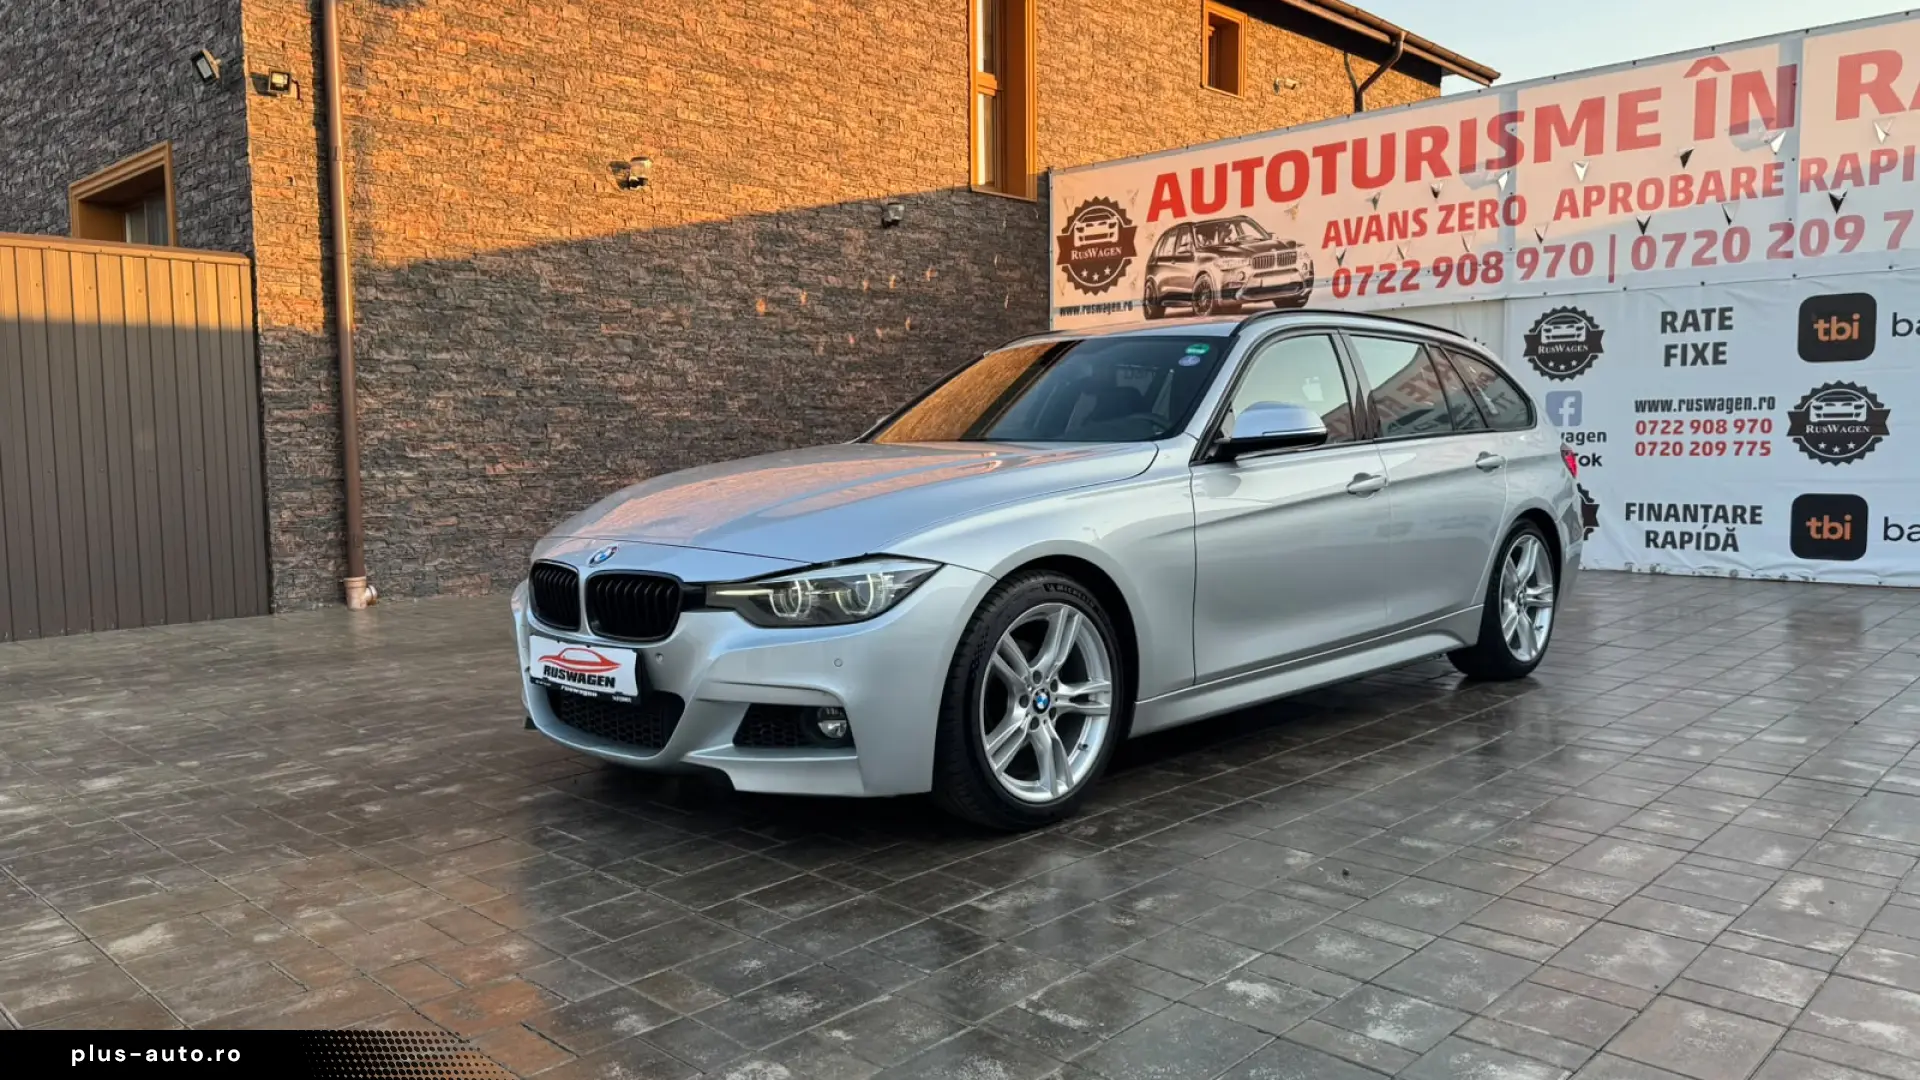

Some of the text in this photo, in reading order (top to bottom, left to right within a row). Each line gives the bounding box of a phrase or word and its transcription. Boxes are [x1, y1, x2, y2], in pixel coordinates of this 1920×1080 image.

[1146, 48, 1920, 223] AUTOTURISME ÎN R
[1321, 145, 1916, 249] AVANS ZERO APROBARE RAPI
[1332, 259, 1421, 299] 0722
[1432, 250, 1505, 289] 908
[1516, 241, 1594, 281] 970
[1631, 226, 1751, 272] 0720
[1766, 214, 1865, 260] 209
[1060, 301, 1133, 316] www.ruswagen.ro
[1661, 307, 1734, 334] RATE
[1813, 312, 1861, 341] tbi
[1664, 342, 1728, 367] FIXE
[1634, 396, 1776, 414] www.ruswagen.ro
[1635, 418, 1773, 435] 0722 908 970
[1635, 440, 1771, 456] 0720 209 775
[1645, 526, 1739, 552] RAPIDĂ
[1805, 514, 1853, 541] tbi
[543, 665, 616, 688] RUSWAGEN
